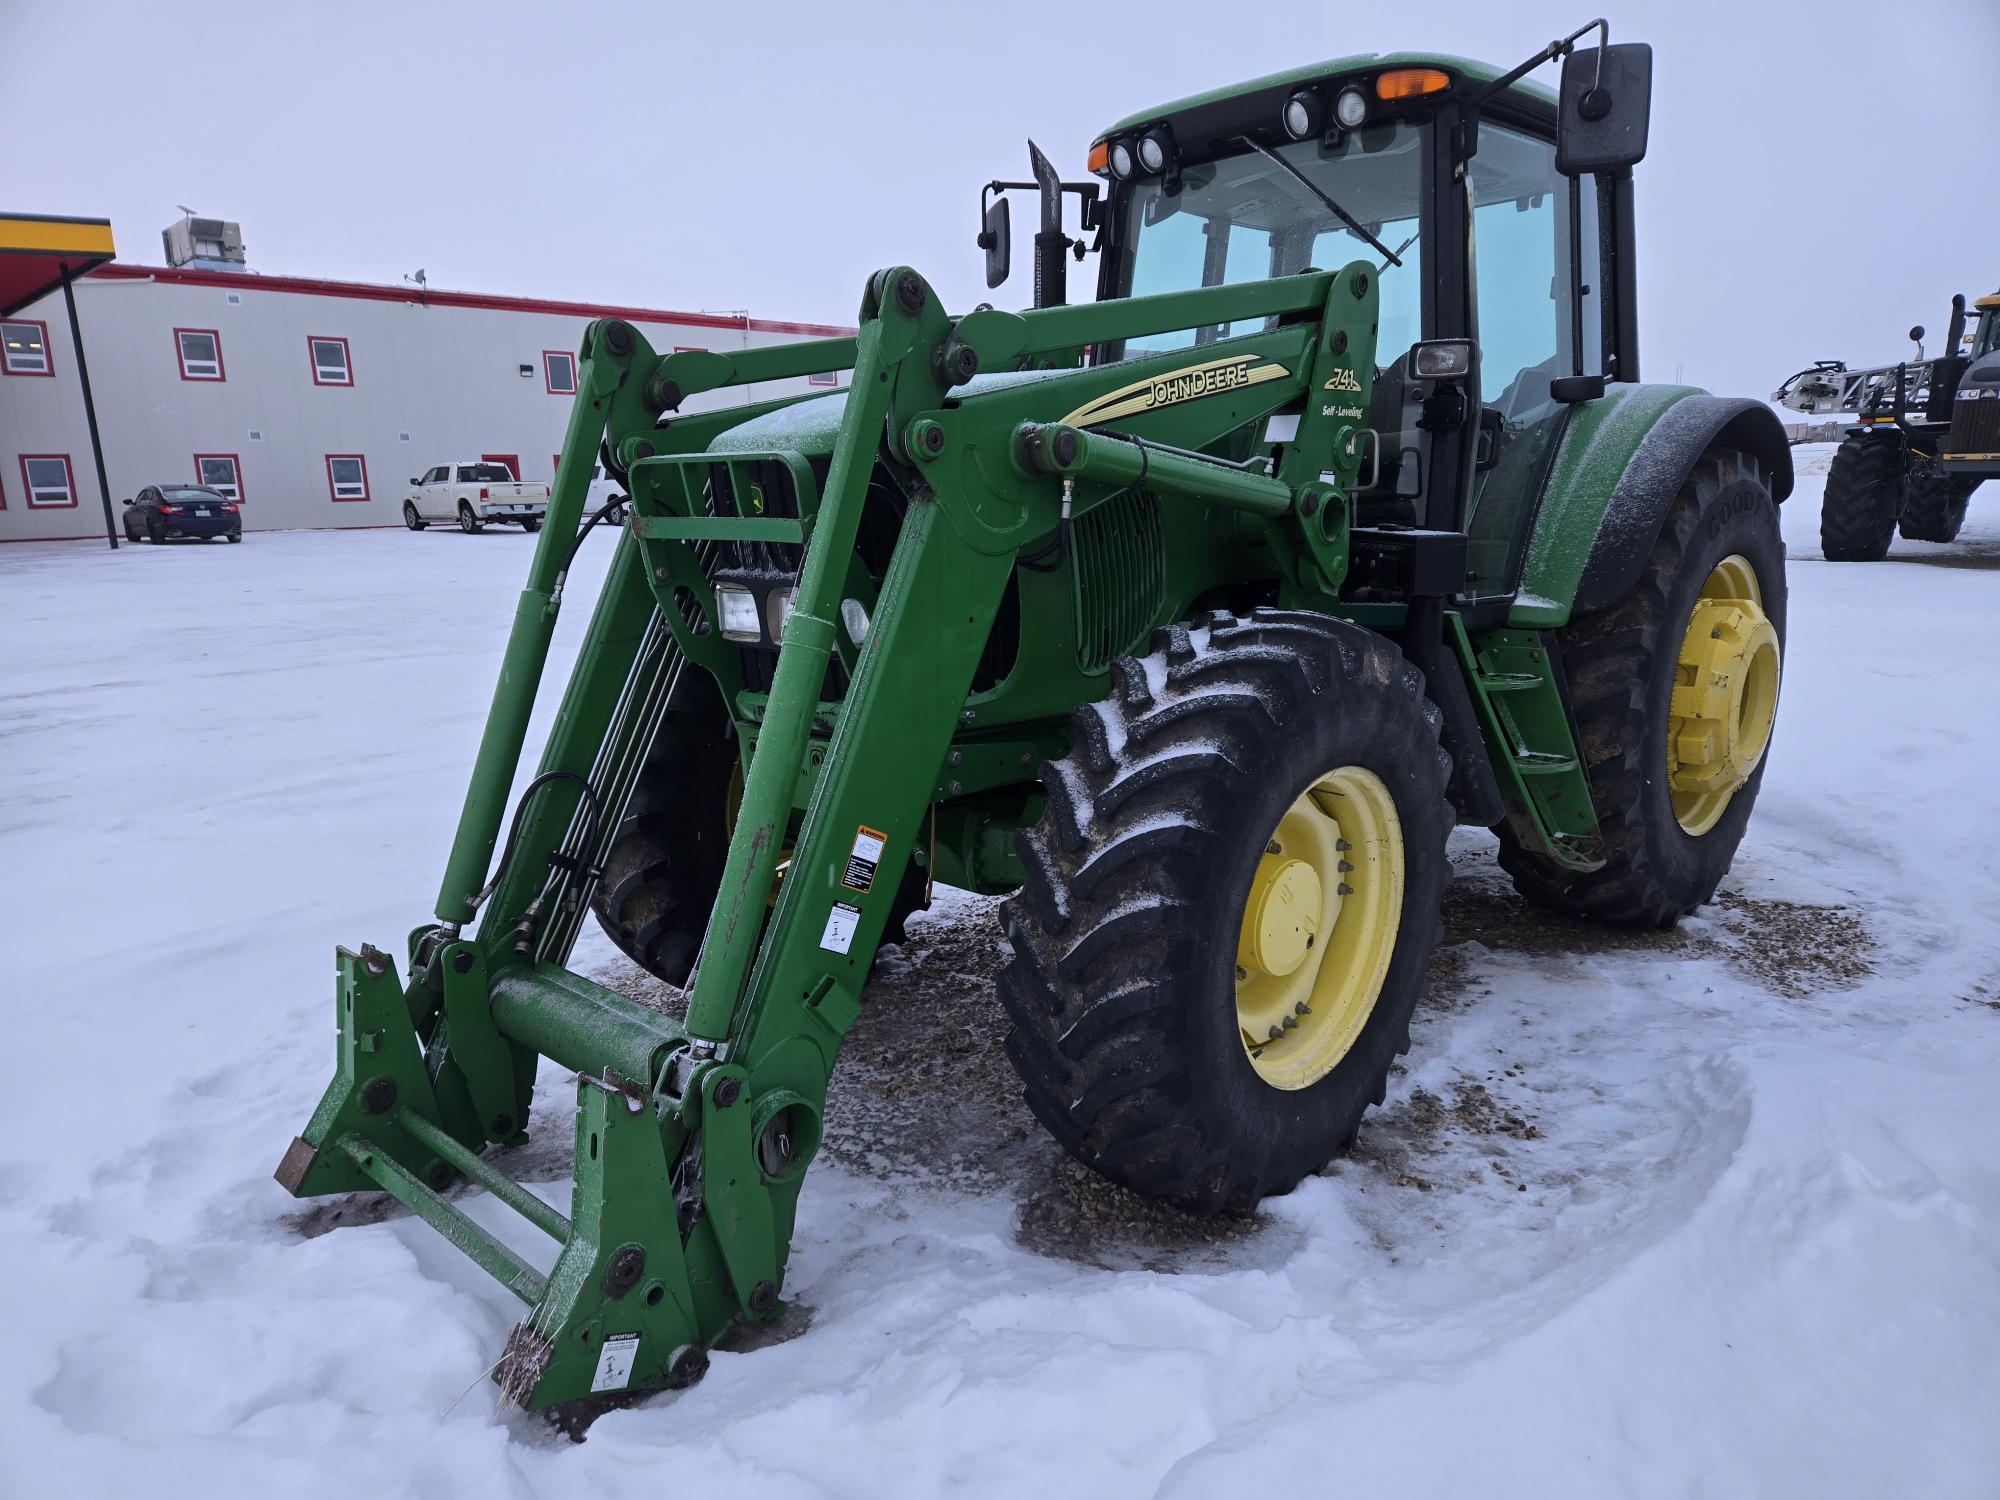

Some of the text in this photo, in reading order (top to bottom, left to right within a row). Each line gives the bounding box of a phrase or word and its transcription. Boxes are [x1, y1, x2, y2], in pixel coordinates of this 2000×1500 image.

[1146, 363, 1248, 406] JOHN DEERE
[1333, 367, 1355, 390] 741
[609, 1332, 637, 1341] IMPORTANT
